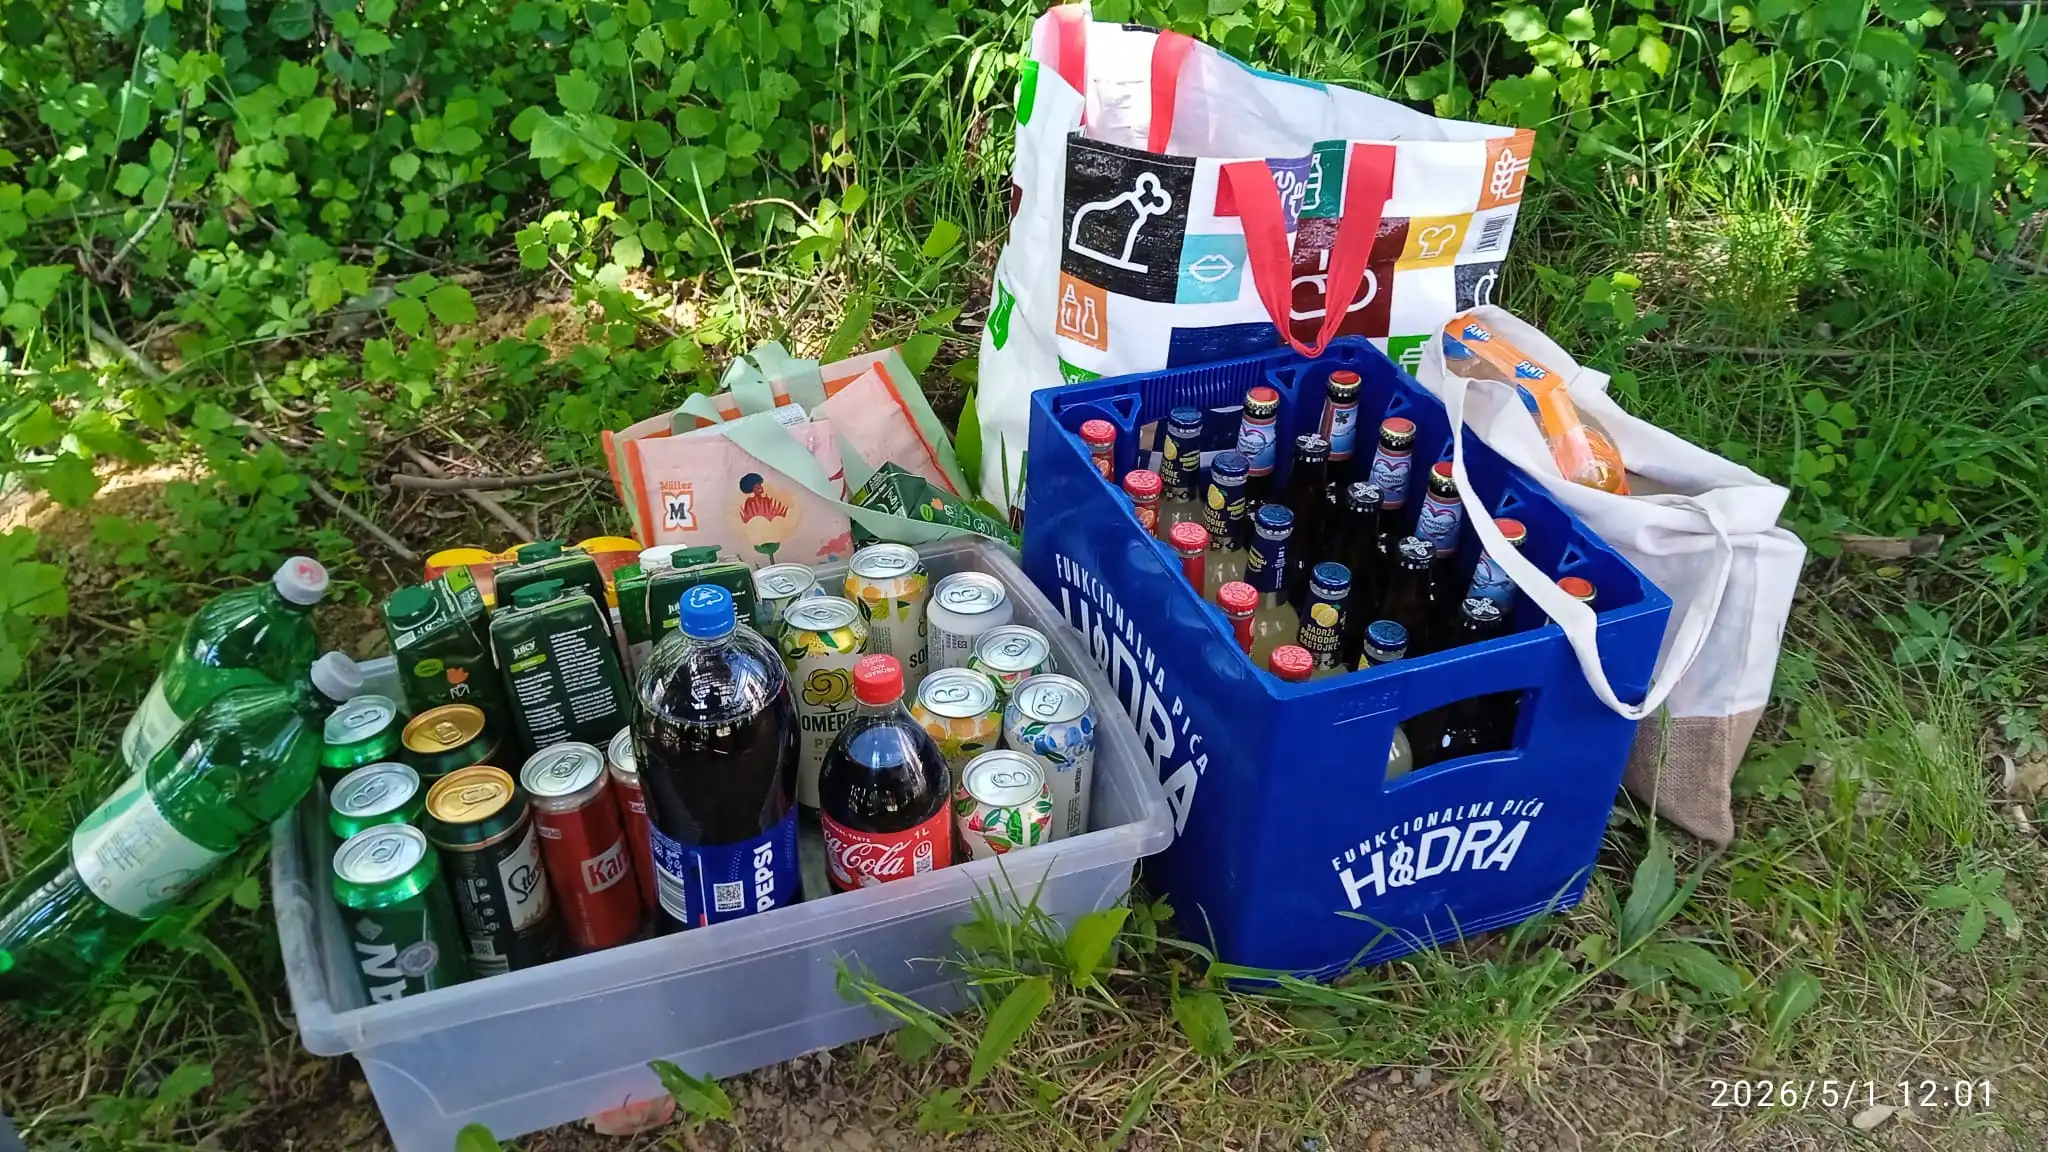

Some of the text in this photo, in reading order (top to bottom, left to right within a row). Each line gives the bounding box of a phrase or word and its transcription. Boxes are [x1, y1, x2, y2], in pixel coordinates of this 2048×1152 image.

[1055, 553, 1209, 777] FUNKCIONALNA PIĆA
[1331, 798, 1545, 871] FUNKCIONALNA PIĆA
[753, 840, 776, 914] PEPSI
